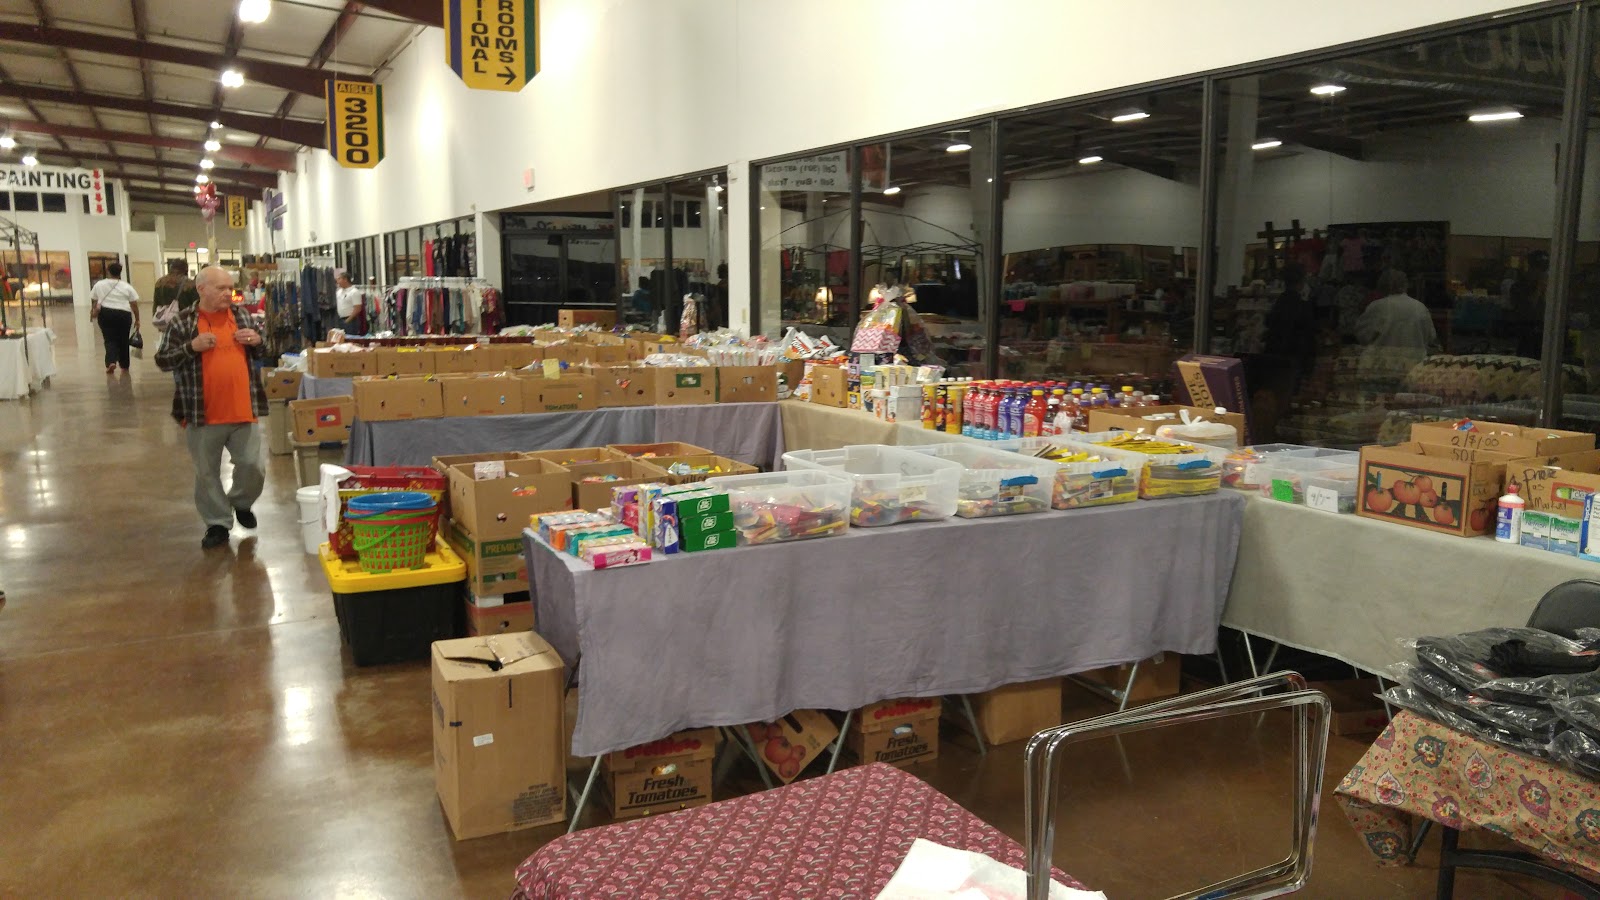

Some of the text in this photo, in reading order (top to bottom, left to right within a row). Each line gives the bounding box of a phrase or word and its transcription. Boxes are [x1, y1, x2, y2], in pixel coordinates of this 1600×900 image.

[337, 83, 373, 95] AISLE
[344, 97, 370, 165] 3200
[0, 169, 91, 189] PAINTING
[887, 732, 918, 749] Fresh
[875, 742, 929, 761] Tomatoes
[643, 774, 685, 791] Fresh
[628, 786, 698, 805] Tomatoes
